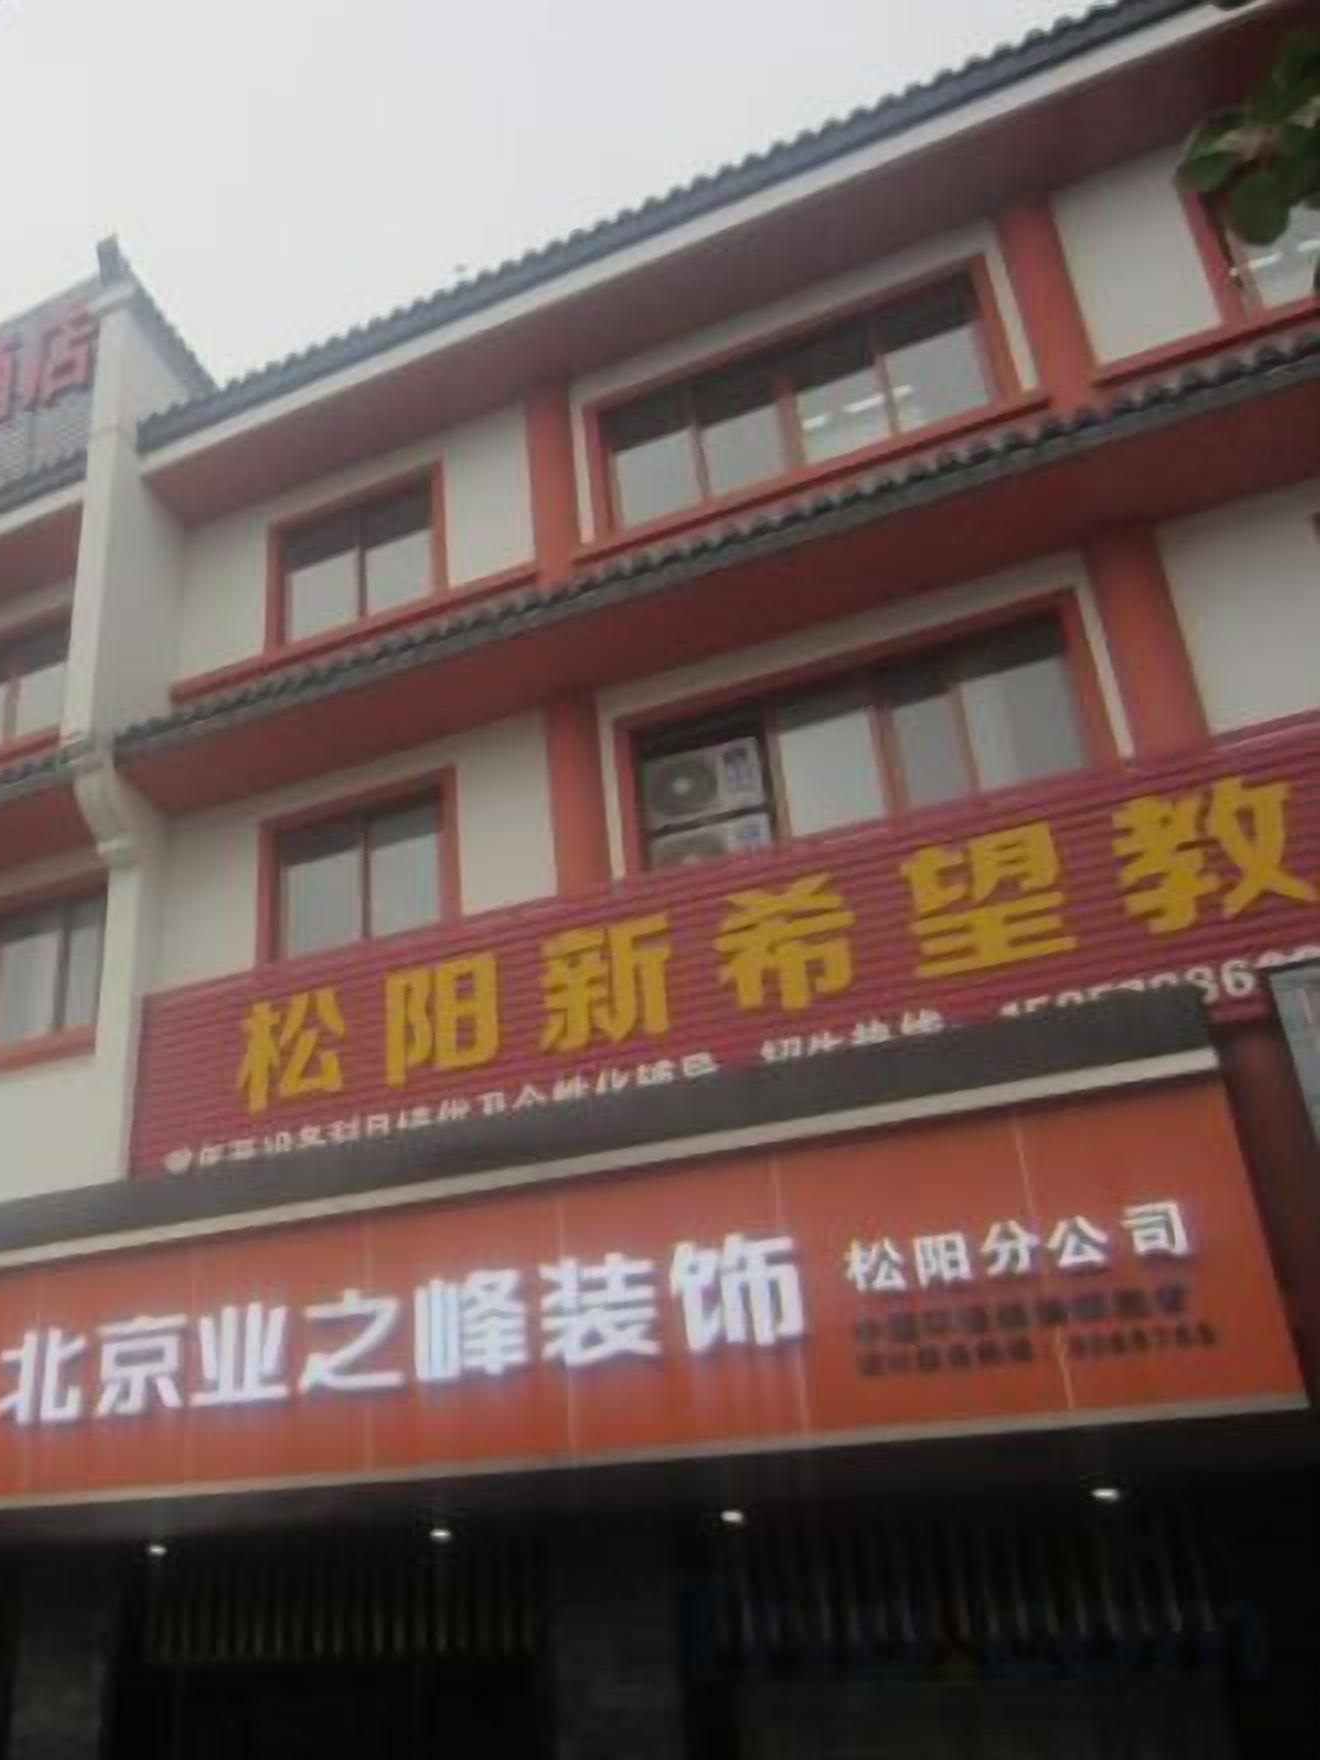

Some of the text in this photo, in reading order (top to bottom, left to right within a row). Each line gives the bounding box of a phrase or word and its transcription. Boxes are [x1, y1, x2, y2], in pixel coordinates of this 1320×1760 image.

[235, 775, 1318, 1114] 松阳新希望教
[844, 1199, 1192, 1293] 松阳分公司
